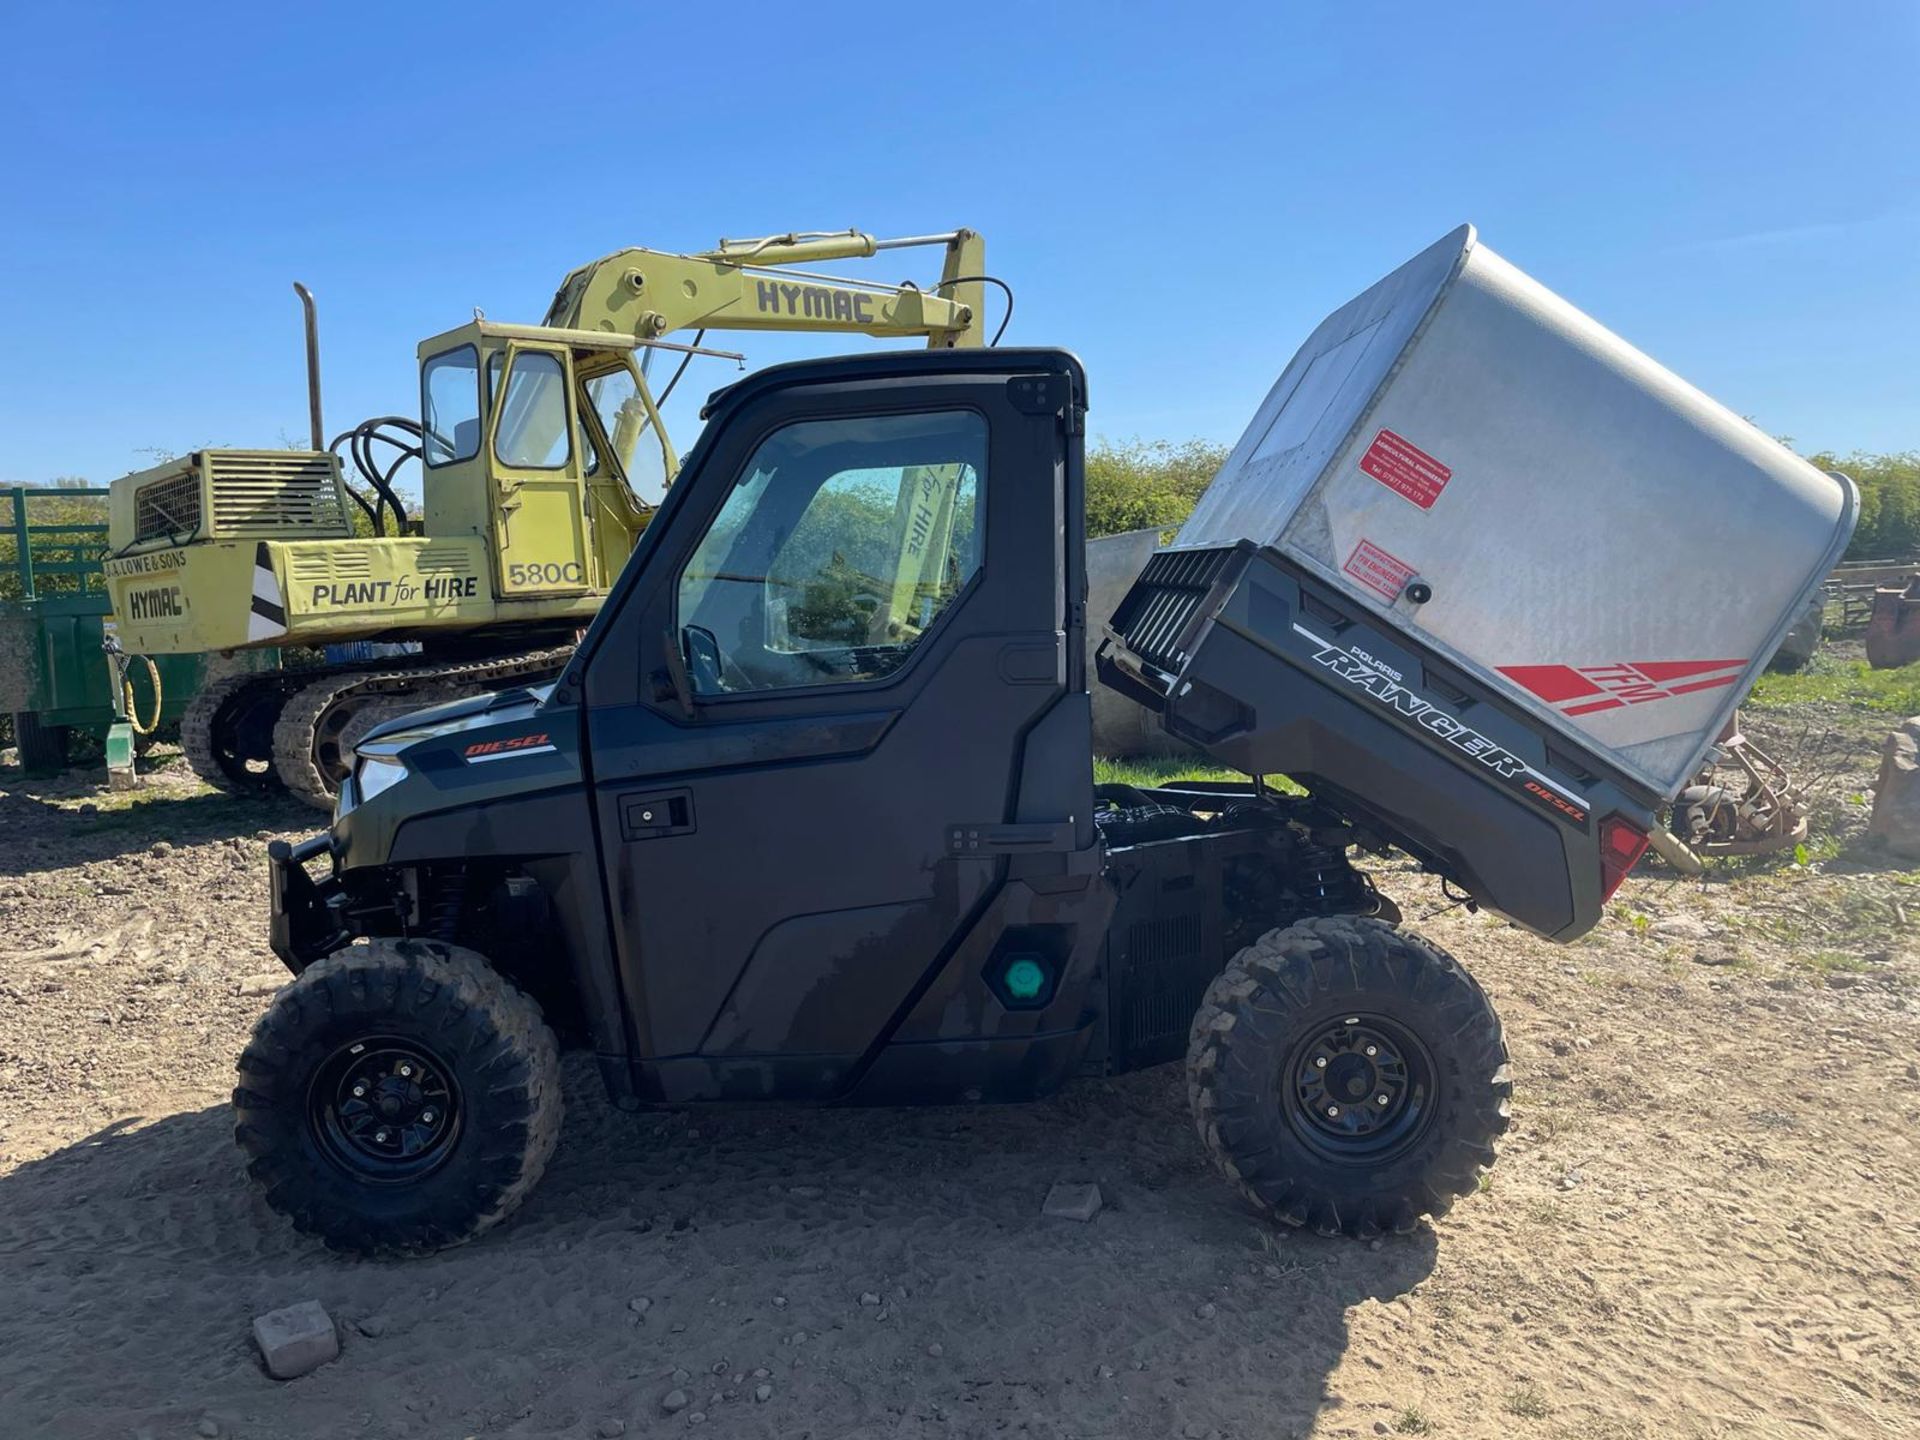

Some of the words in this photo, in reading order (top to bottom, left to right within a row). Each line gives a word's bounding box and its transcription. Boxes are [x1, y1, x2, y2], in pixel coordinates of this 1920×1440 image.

[757, 281, 874, 323] HYMAC
[1375, 440, 1416, 468] AGRICULTURAL
[1415, 463, 1445, 486] ENGINEERS
[908, 504, 932, 557] HIRE
[159, 551, 187, 569] SONS
[509, 562, 582, 586] 580C
[130, 586, 183, 620] HYMAC
[313, 581, 391, 606] PLANT
[392, 573, 420, 606] for
[424, 577, 478, 599] HIRE
[1350, 645, 1403, 681] POLARIS
[1577, 662, 1672, 705] TFM
[1312, 646, 1527, 778] RANGER
[464, 733, 550, 756] DIESEL
[1524, 781, 1585, 822] DIESEL
